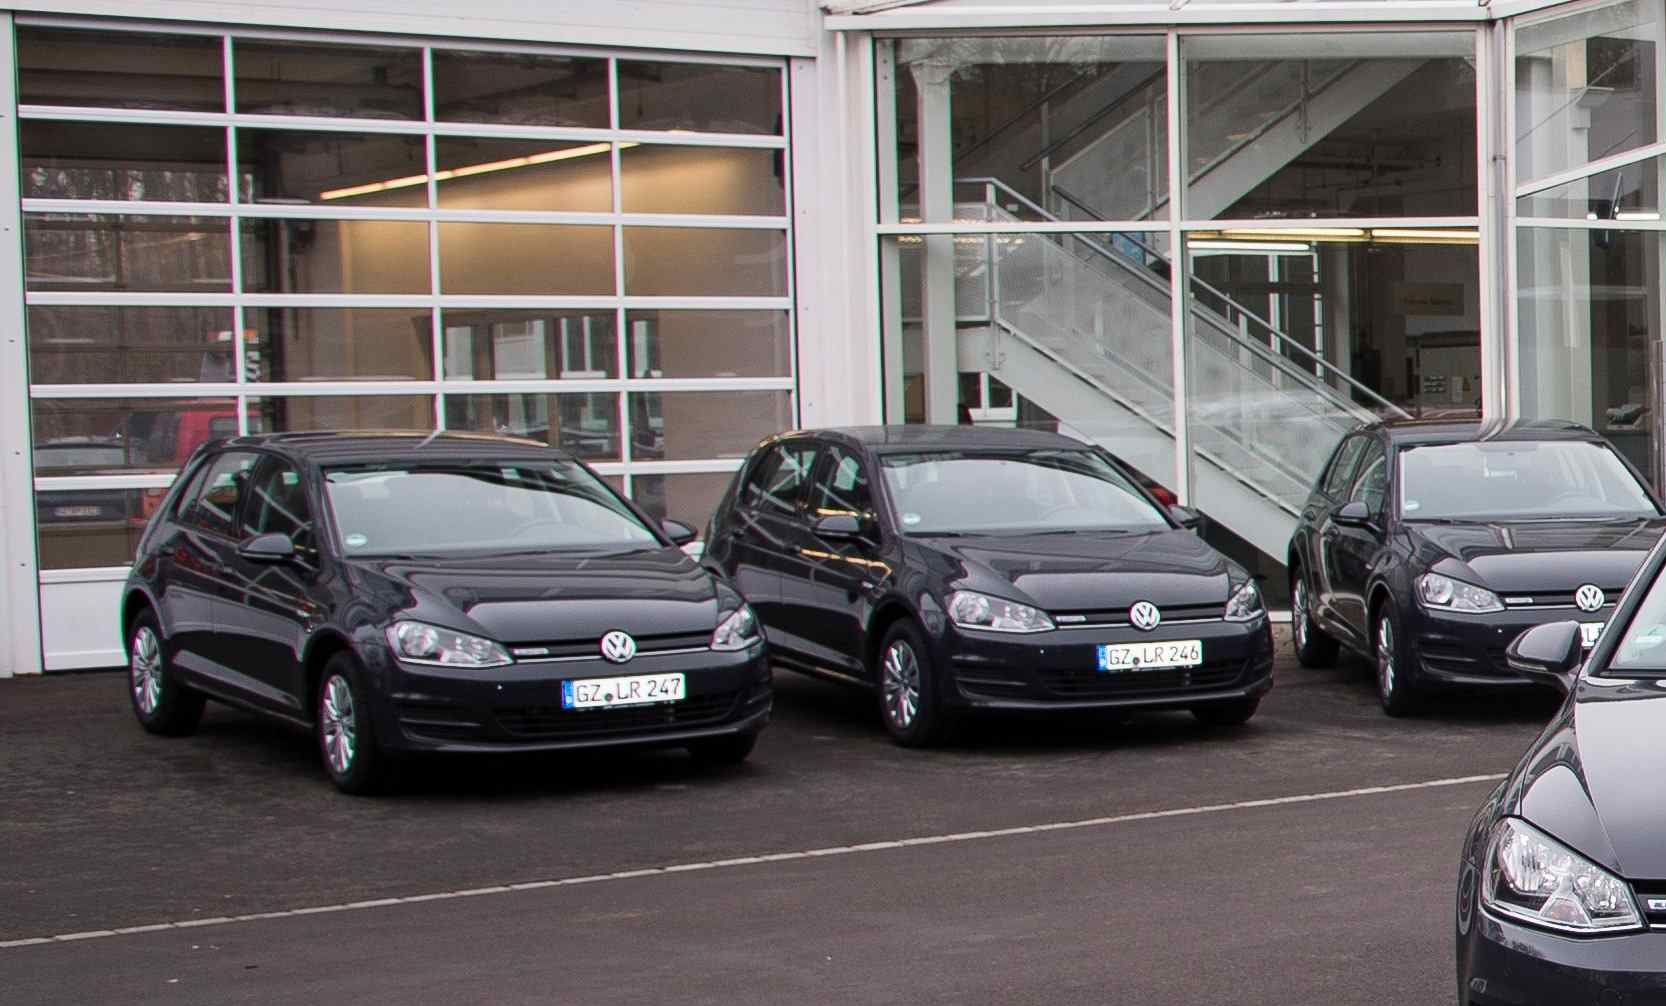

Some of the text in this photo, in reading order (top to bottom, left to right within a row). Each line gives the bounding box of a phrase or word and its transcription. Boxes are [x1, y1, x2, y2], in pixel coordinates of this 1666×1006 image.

[1109, 645, 1199, 666] GZ LR 246
[576, 678, 681, 704] GZ LR 247
